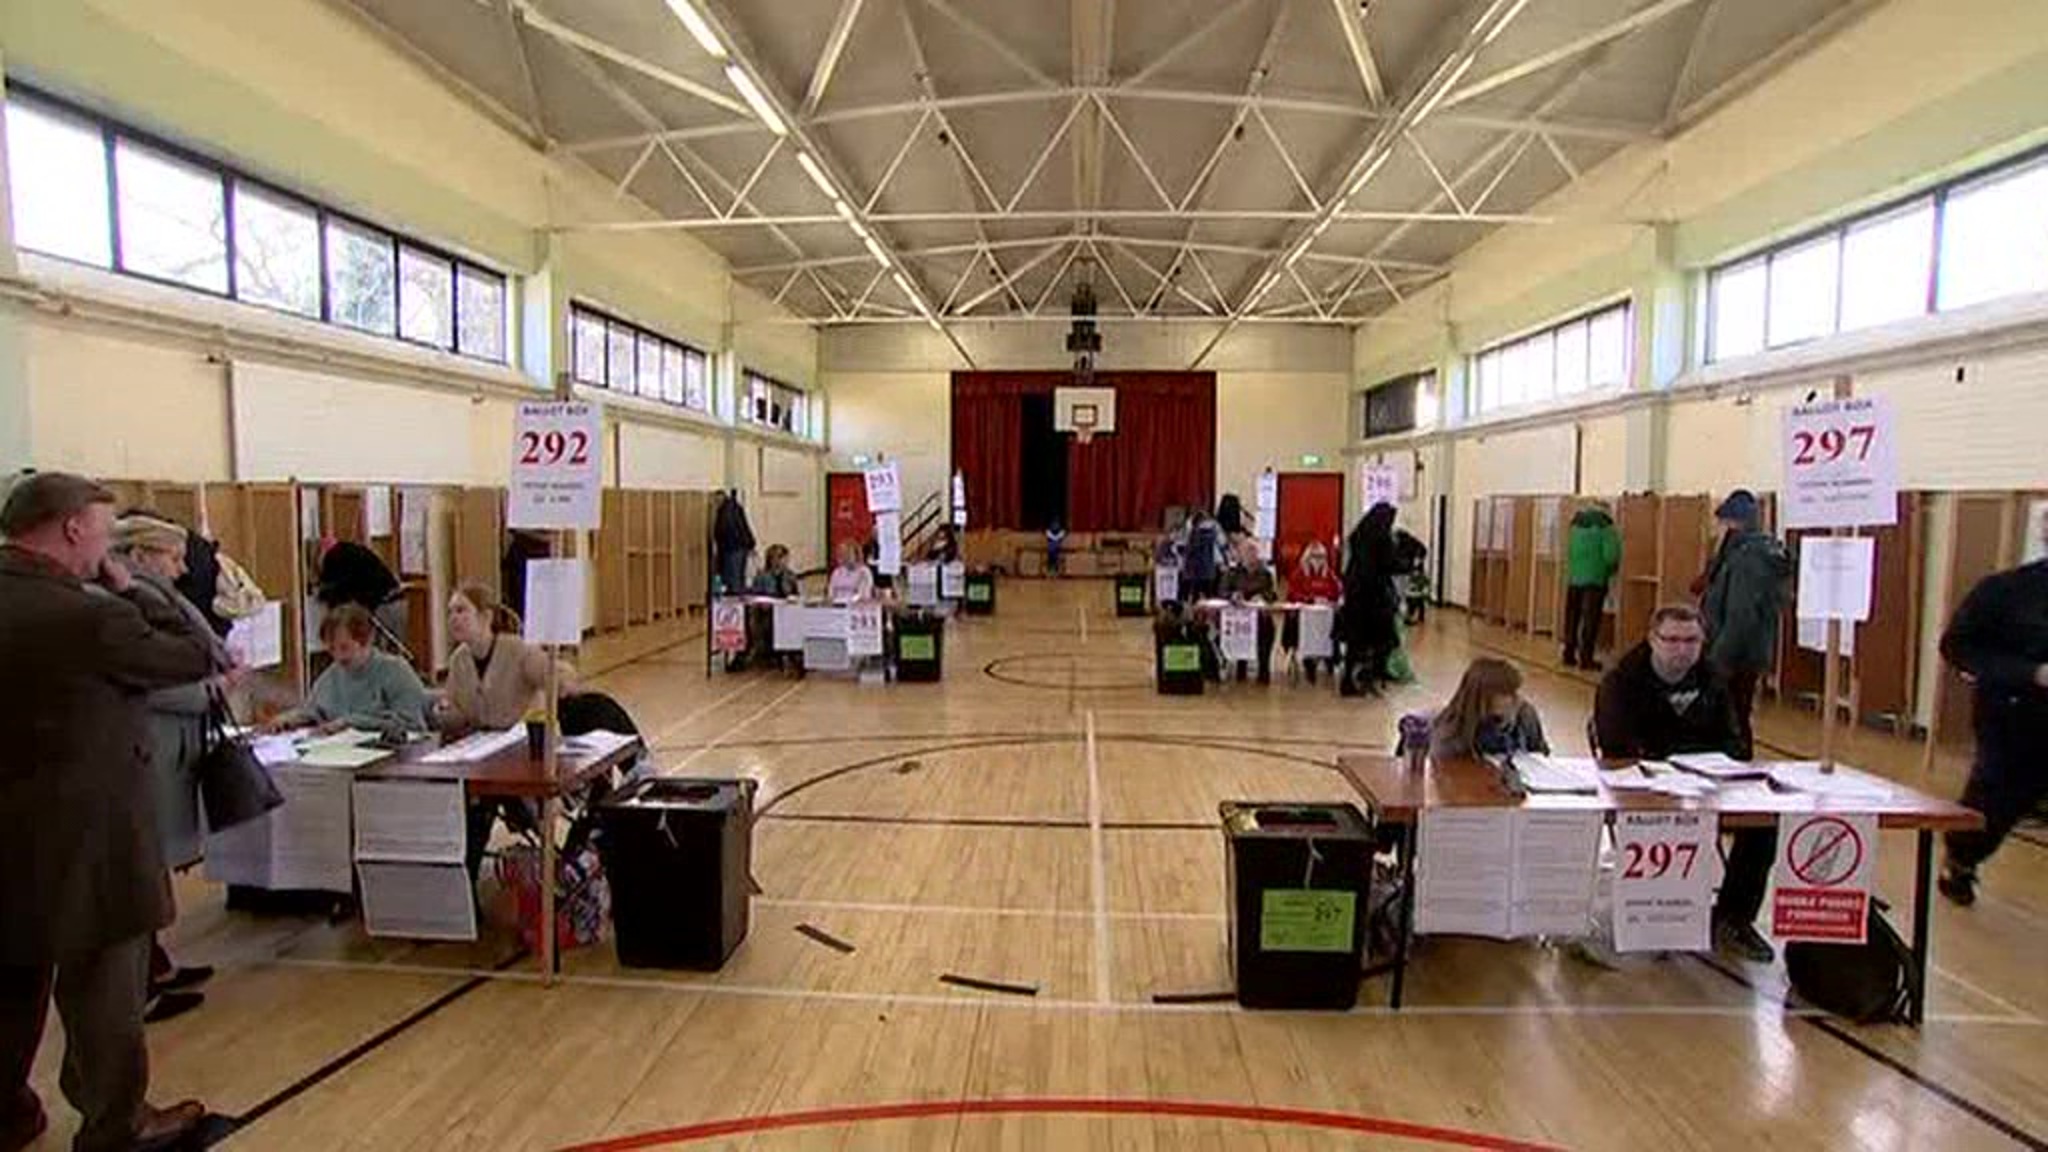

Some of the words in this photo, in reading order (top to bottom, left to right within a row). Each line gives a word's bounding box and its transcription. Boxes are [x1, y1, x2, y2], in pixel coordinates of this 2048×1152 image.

[520, 430, 588, 465] 292
[1792, 425, 1875, 465] 297
[1622, 841, 1699, 879] 297
